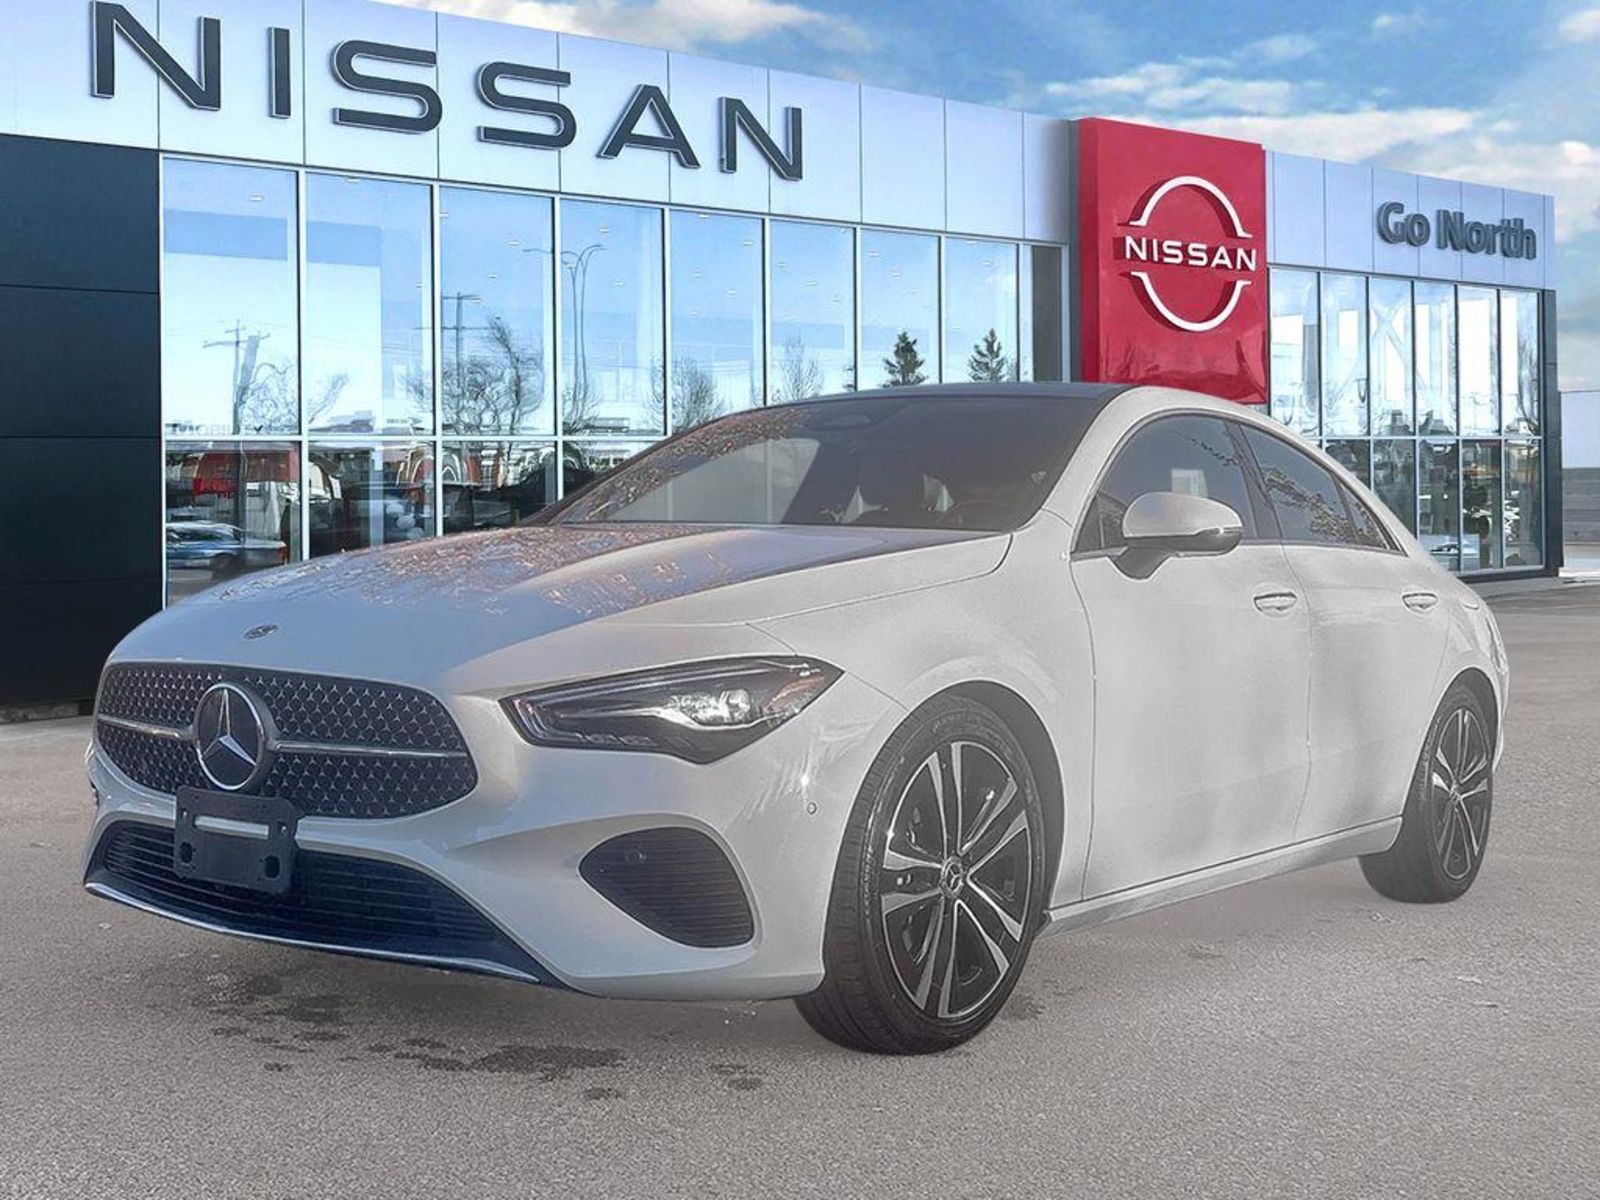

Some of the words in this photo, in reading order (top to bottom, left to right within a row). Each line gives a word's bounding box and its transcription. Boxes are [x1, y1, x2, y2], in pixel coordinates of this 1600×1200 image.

[90, 0, 803, 180] NISSAN
[1124, 235, 1257, 272] NISSAN
[1378, 202, 1430, 248] Go
[1436, 209, 1537, 260] North
